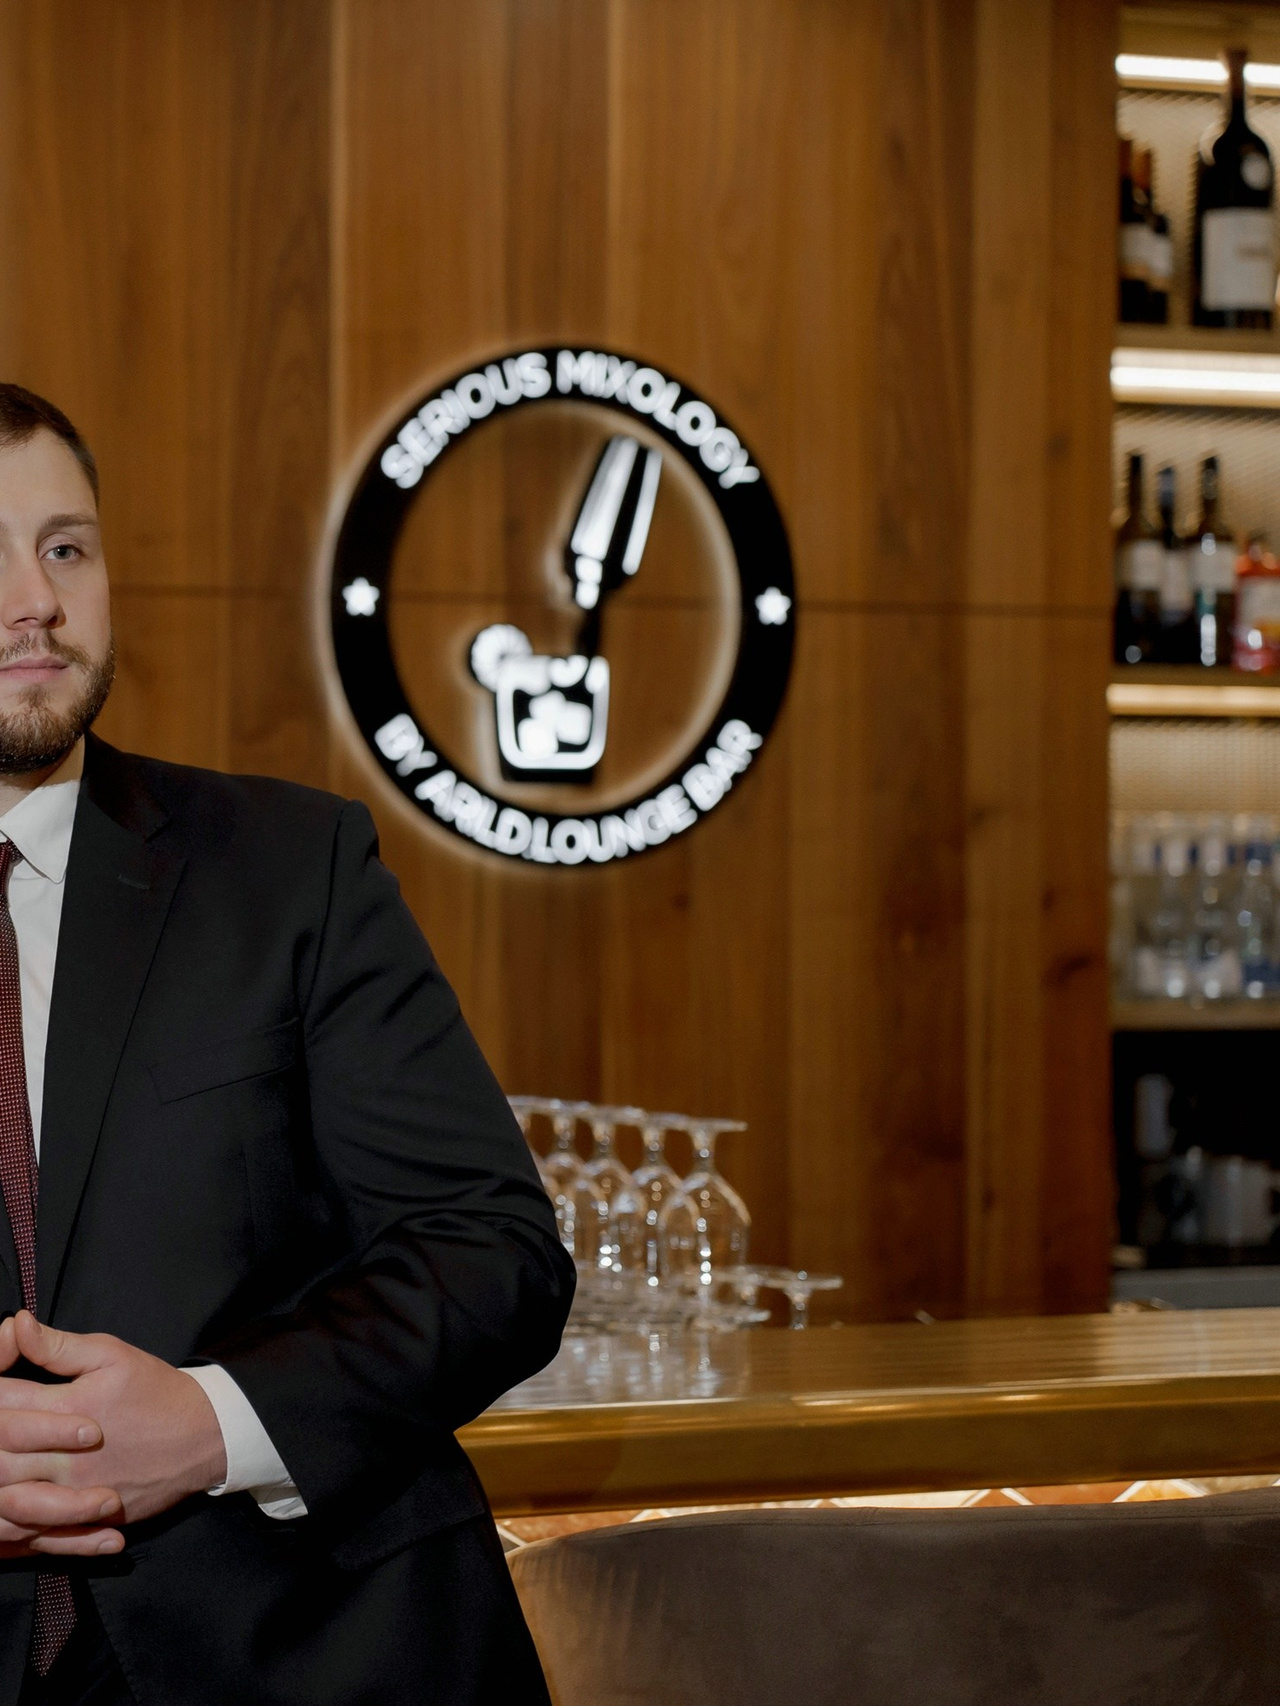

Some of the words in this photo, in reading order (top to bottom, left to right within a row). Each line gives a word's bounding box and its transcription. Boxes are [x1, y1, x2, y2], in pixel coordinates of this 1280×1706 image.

[381, 352, 552, 488] SERIOUS
[557, 351, 759, 488] MIXOLOGY
[375, 714, 437, 776] BY
[682, 719, 762, 811] BAR
